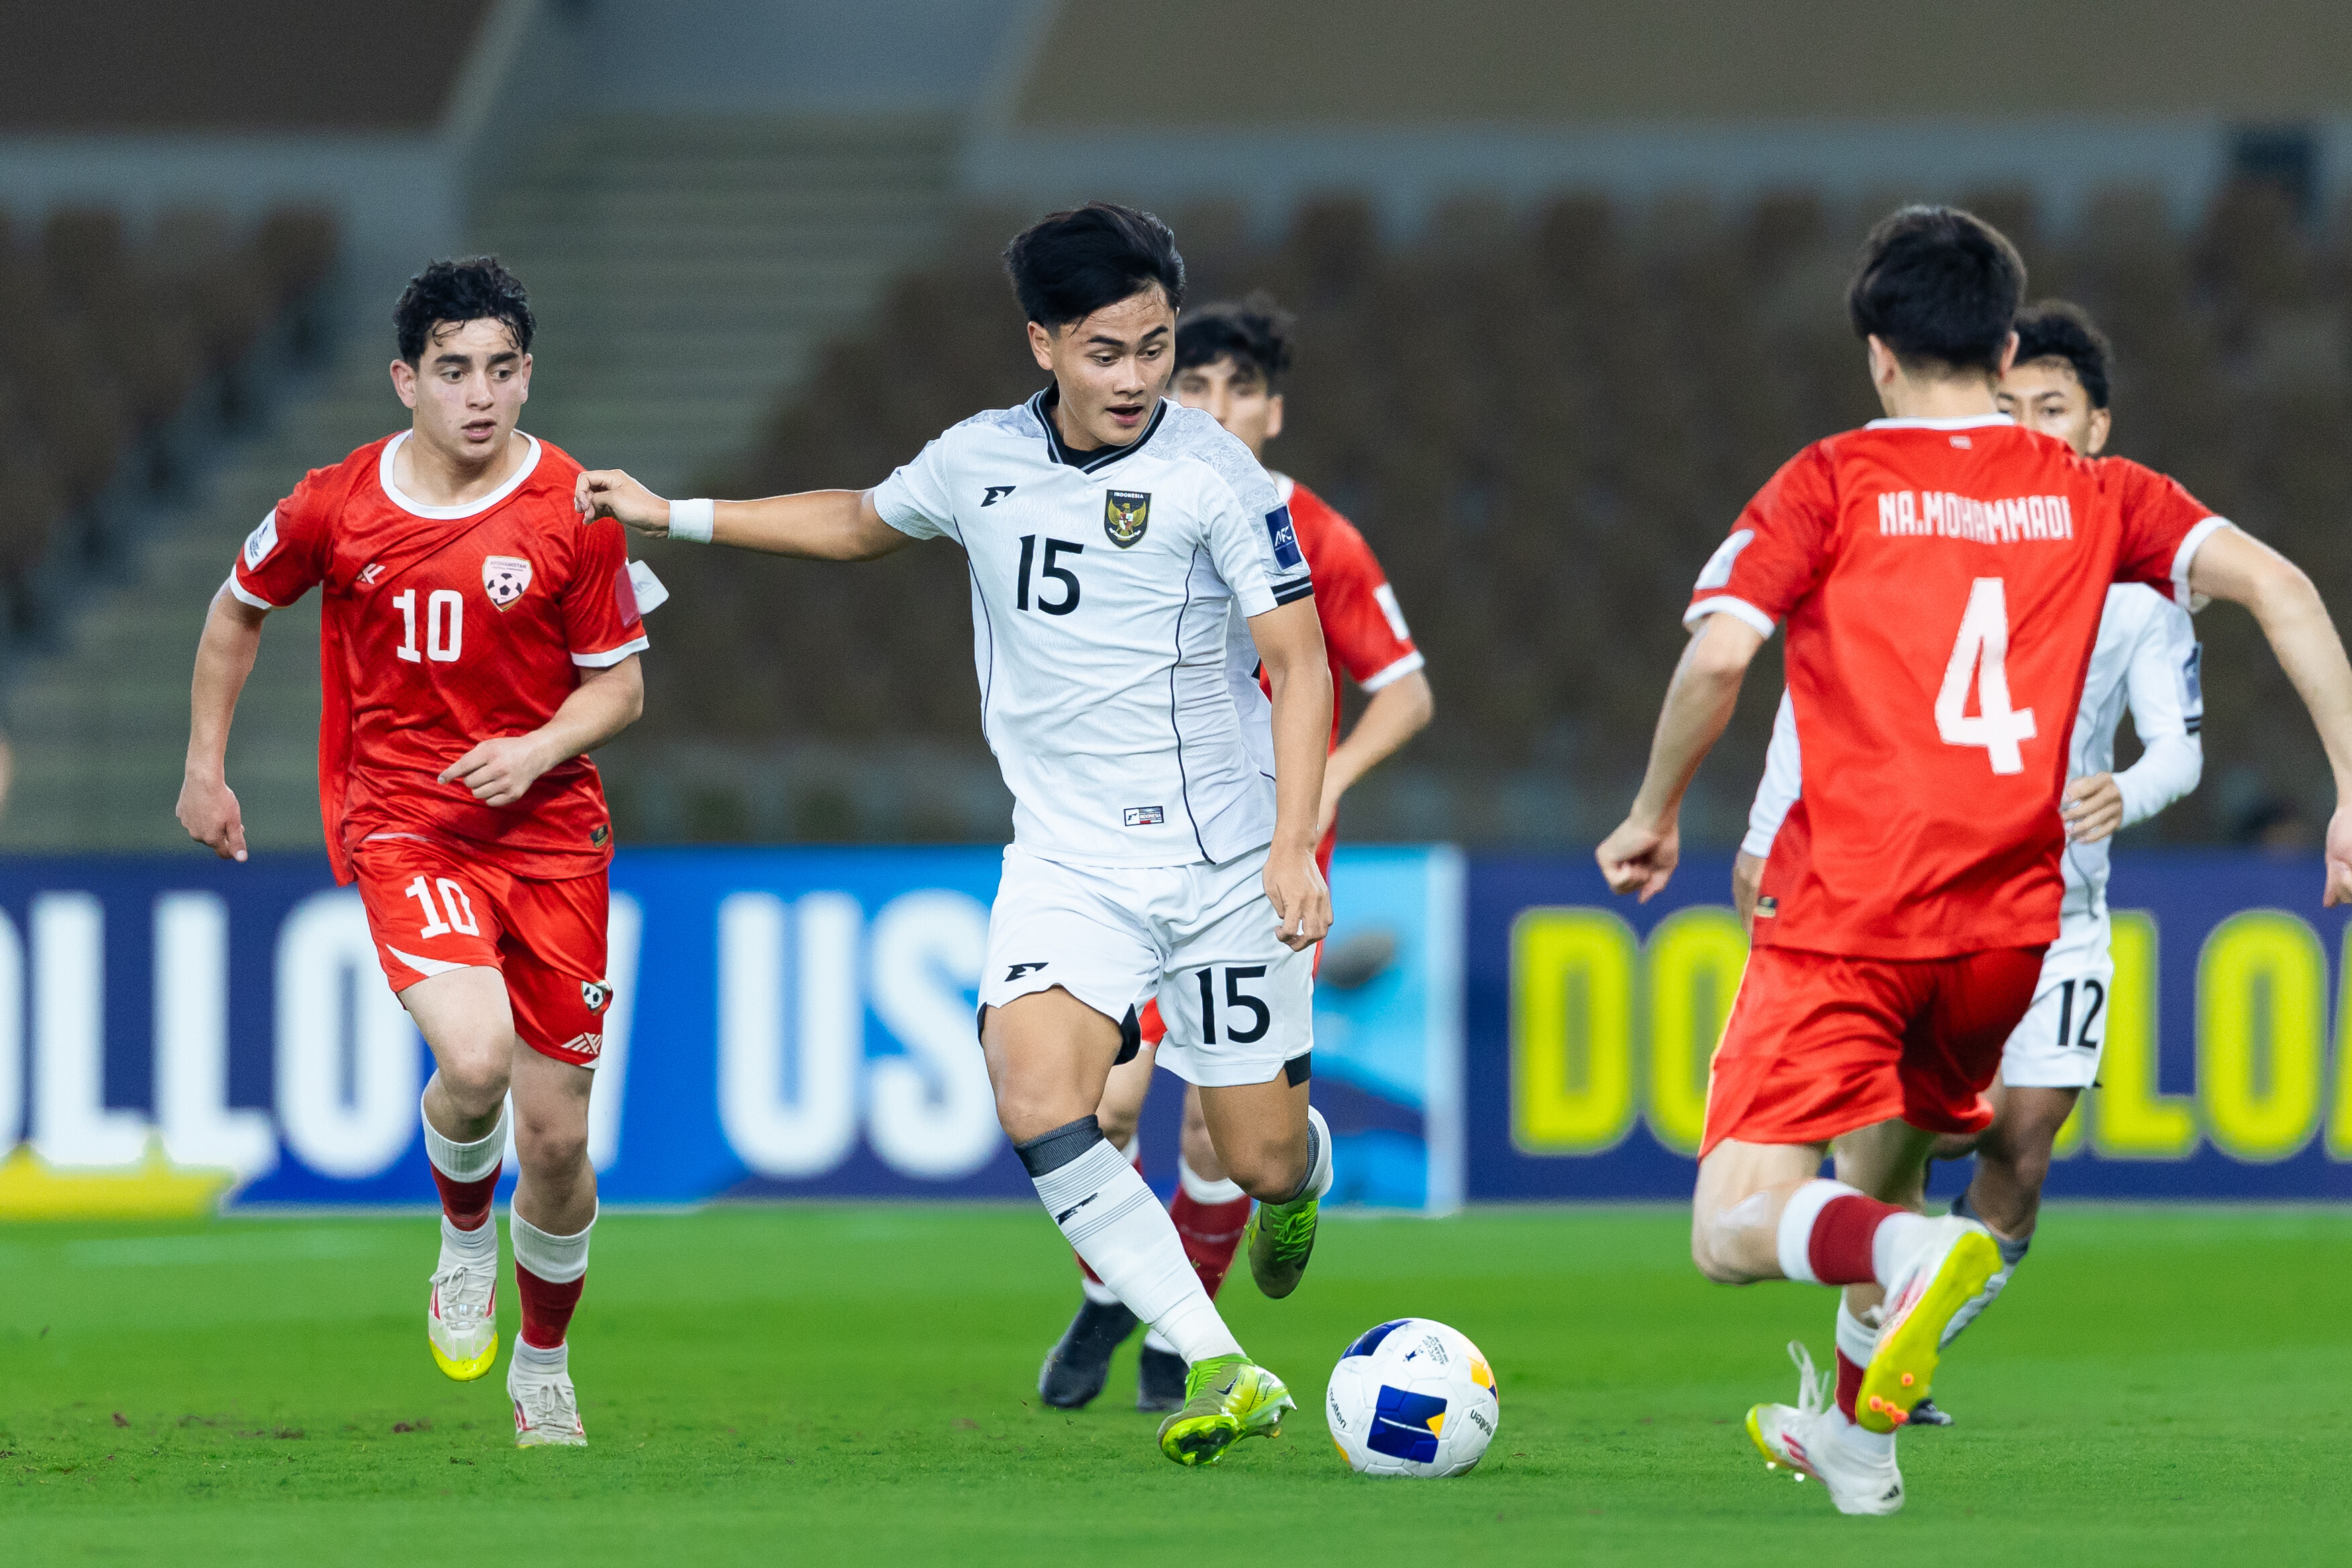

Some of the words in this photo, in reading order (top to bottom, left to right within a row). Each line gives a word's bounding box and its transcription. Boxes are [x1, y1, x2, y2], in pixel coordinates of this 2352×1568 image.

[1275, 525, 1292, 546] AFC
[1878, 491, 2073, 544] NA.MOHAMMADI
[1016, 534, 1084, 616] 15
[393, 589, 463, 663] 10
[1935, 577, 2037, 775] 4
[405, 875, 479, 940] 10
[0, 891, 642, 1179] LLO
[717, 889, 1005, 1179] US
[1195, 965, 1271, 1045] 15
[1510, 906, 2352, 1163] DOLO
[2057, 978, 2105, 1050] 12
[1329, 1387, 1346, 1429] molten
[1470, 1409, 1493, 1437] molten
